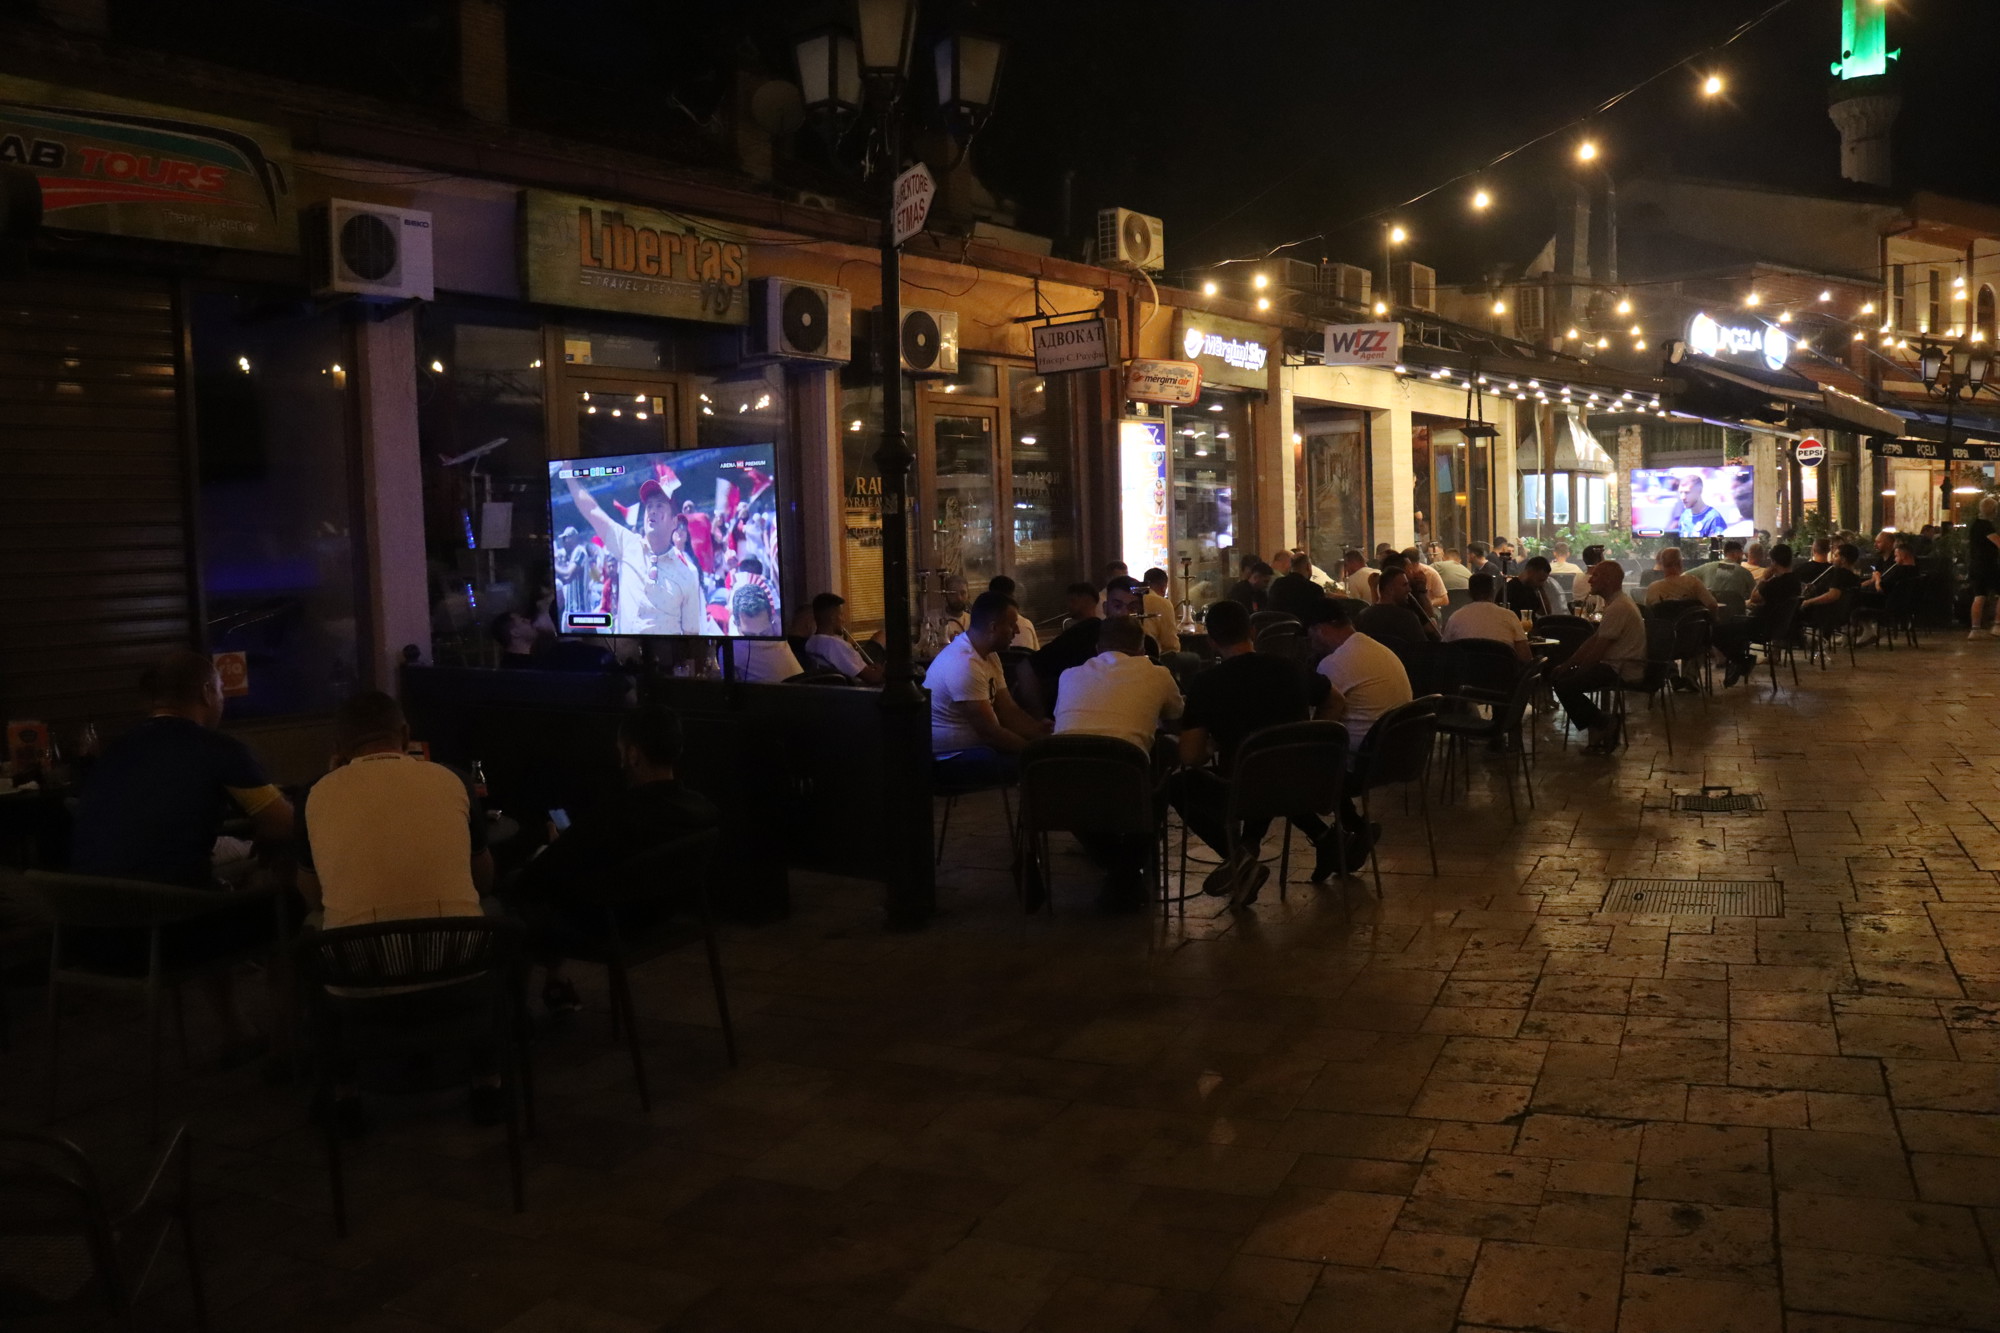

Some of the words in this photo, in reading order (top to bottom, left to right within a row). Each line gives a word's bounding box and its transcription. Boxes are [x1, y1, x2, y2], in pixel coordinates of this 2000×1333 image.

[0, 134, 66, 169] AB
[80, 148, 230, 191] TOURS
[579, 206, 743, 287] Libertas
[595, 276, 638, 291] TRAVEL
[1038, 326, 1105, 350] АДВОКАТ
[1360, 352, 1385, 360] Agent
[1144, 374, 1178, 386] mërgimi
[1178, 377, 1191, 386] air
